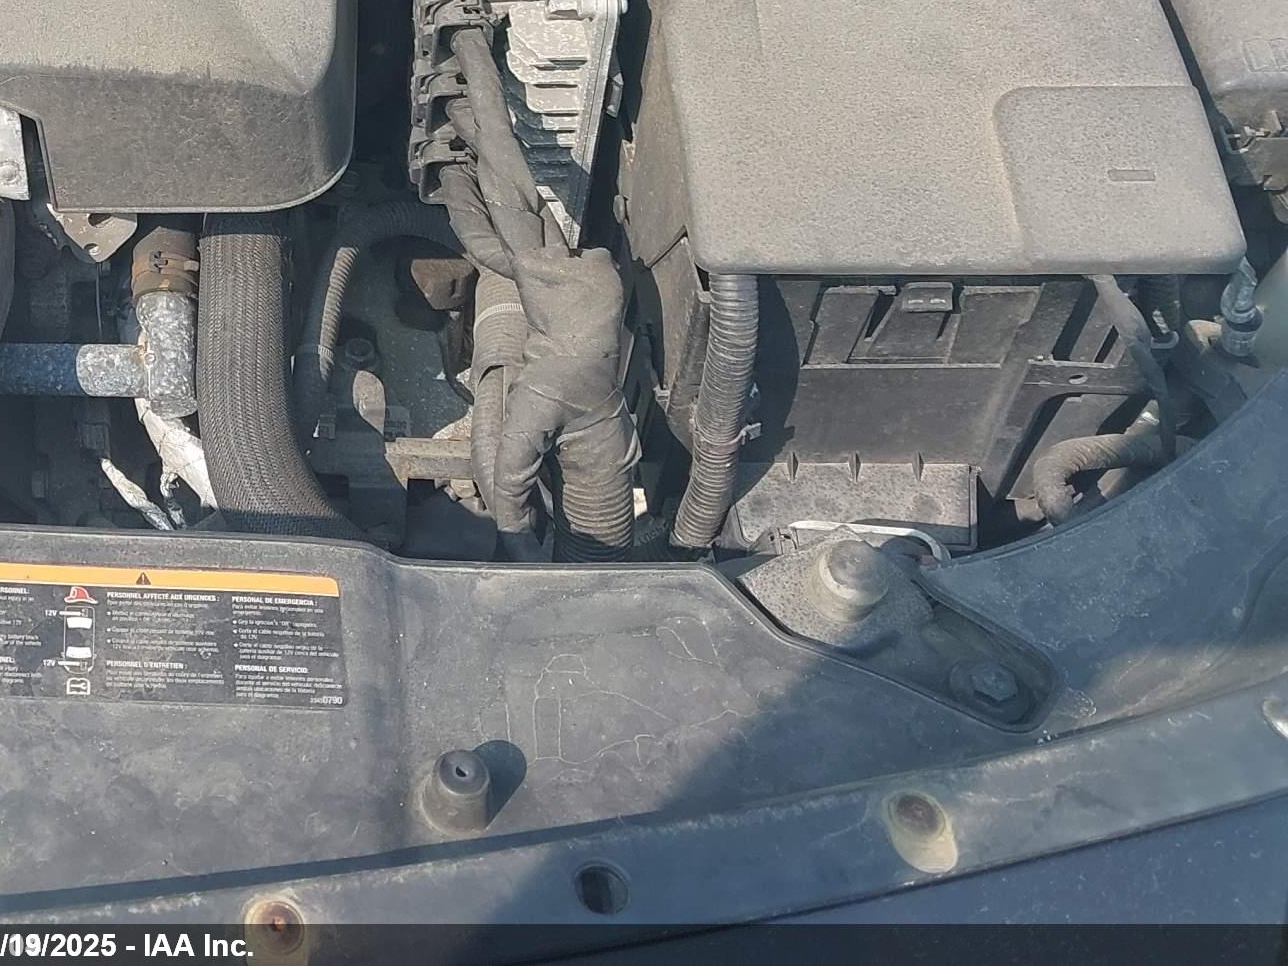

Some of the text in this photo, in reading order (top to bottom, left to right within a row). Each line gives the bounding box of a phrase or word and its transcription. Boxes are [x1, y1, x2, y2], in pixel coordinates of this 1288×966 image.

[143, 592, 169, 600] AFFECTÉ
[184, 594, 217, 602] URGENCES
[274, 598, 314, 606] EMERGENCIA
[106, 660, 142, 668] PERSONNEL
[234, 664, 268, 672] PERSONAL
